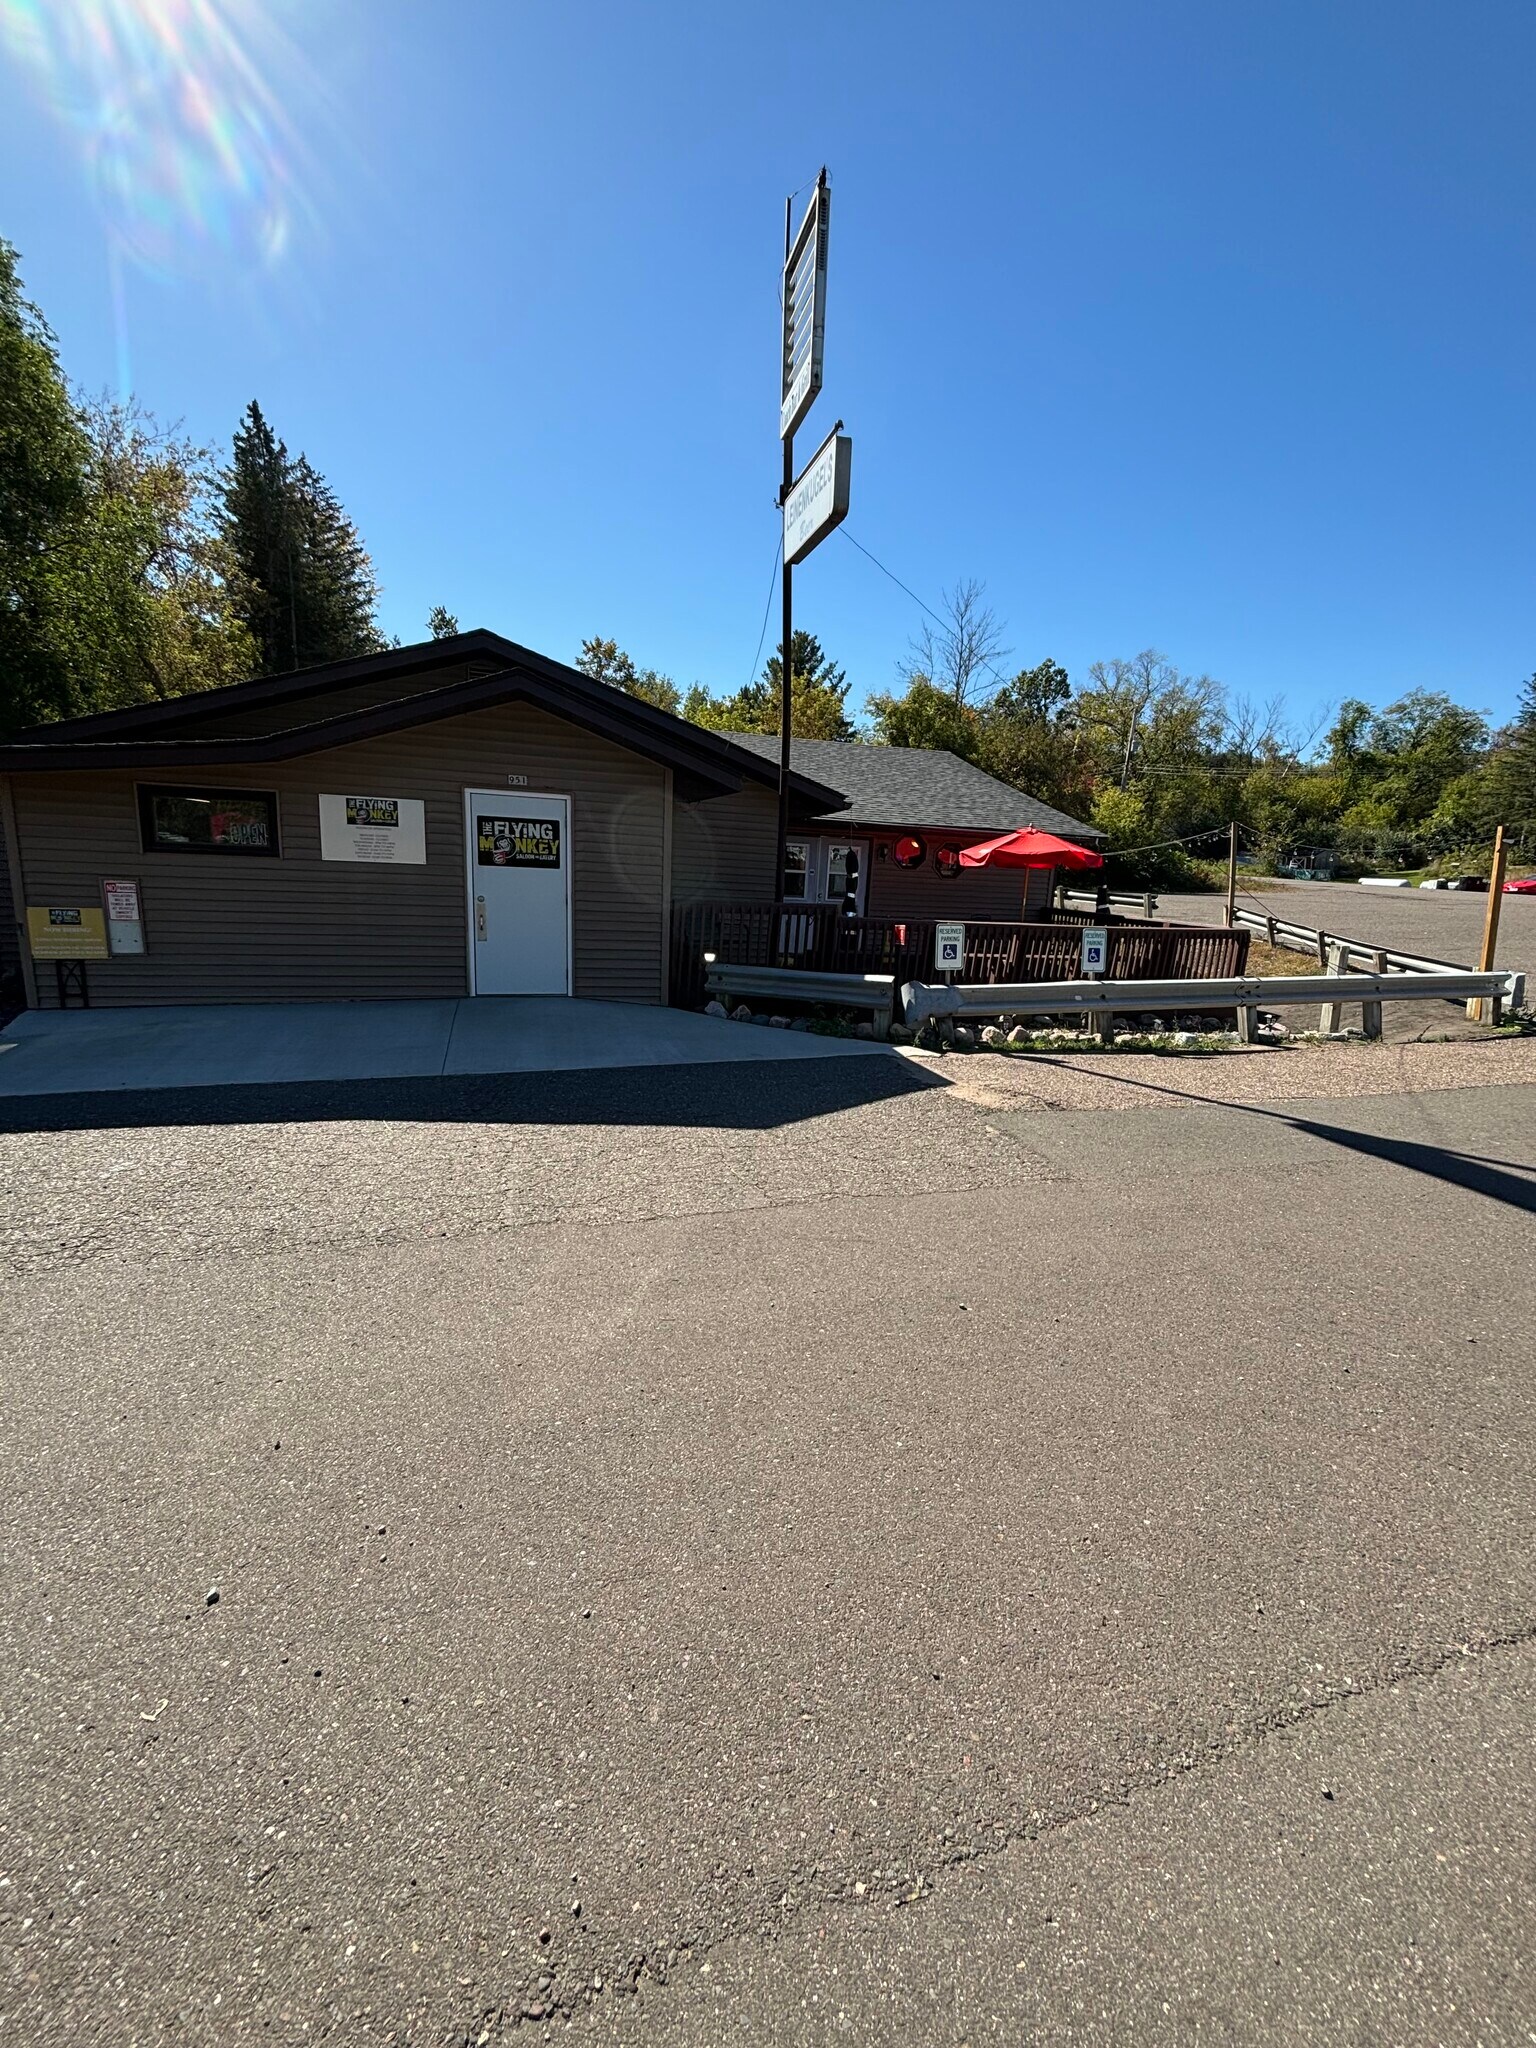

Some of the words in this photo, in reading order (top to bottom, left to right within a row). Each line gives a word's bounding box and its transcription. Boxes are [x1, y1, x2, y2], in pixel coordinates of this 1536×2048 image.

[509, 776, 526, 784] 951
[230, 822, 267, 845] OPEN
[483, 821, 493, 835] THE
[479, 835, 560, 855] MONKEY
[106, 883, 116, 892] NO
